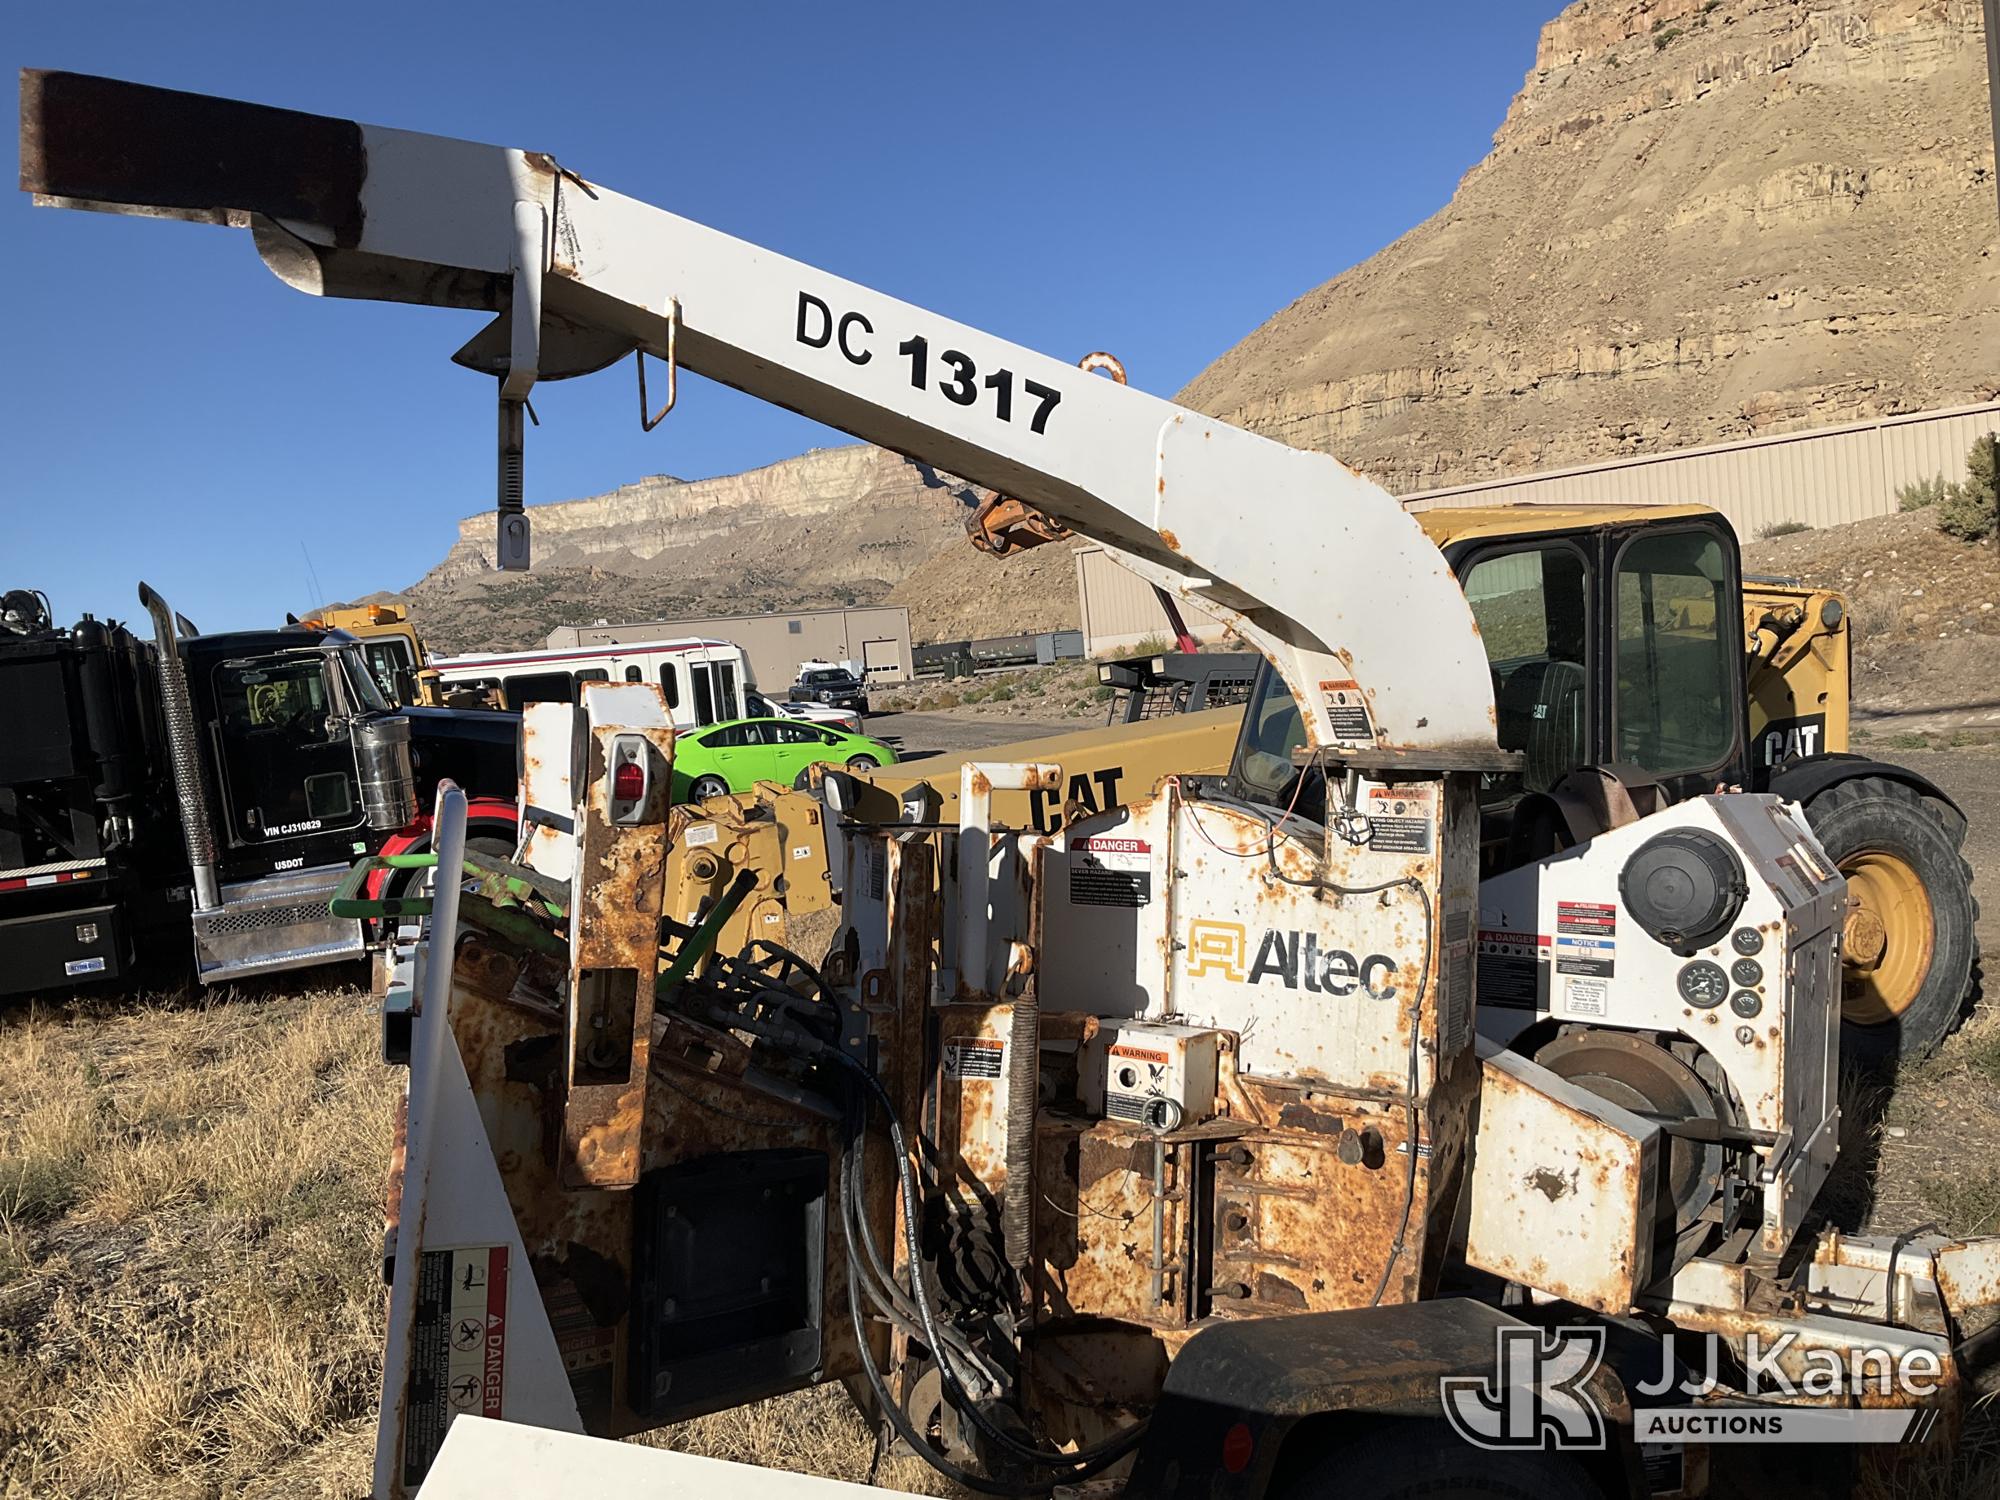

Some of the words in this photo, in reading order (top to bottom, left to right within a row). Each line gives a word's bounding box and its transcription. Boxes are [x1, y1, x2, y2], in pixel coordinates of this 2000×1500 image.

[796, 290, 874, 366] DC
[899, 334, 1062, 436] 1317
[1765, 724, 1819, 766] CAT
[1029, 766, 1124, 836] CAT
[263, 826, 280, 837] VIN
[281, 820, 321, 834] CJ310829
[1092, 840, 1138, 852] DANGER
[274, 857, 304, 871] USDOT
[1495, 932, 1537, 945] DANGER
[1571, 938, 1600, 948] NOTICE
[1246, 927, 1399, 1001] Altec
[1121, 1047, 1163, 1062] WARNING
[441, 1312, 451, 1344] SEVER
[439, 1353, 449, 1388] CRUSH
[484, 1334, 504, 1410] DANGER
[437, 1389, 448, 1429] HAZARD
